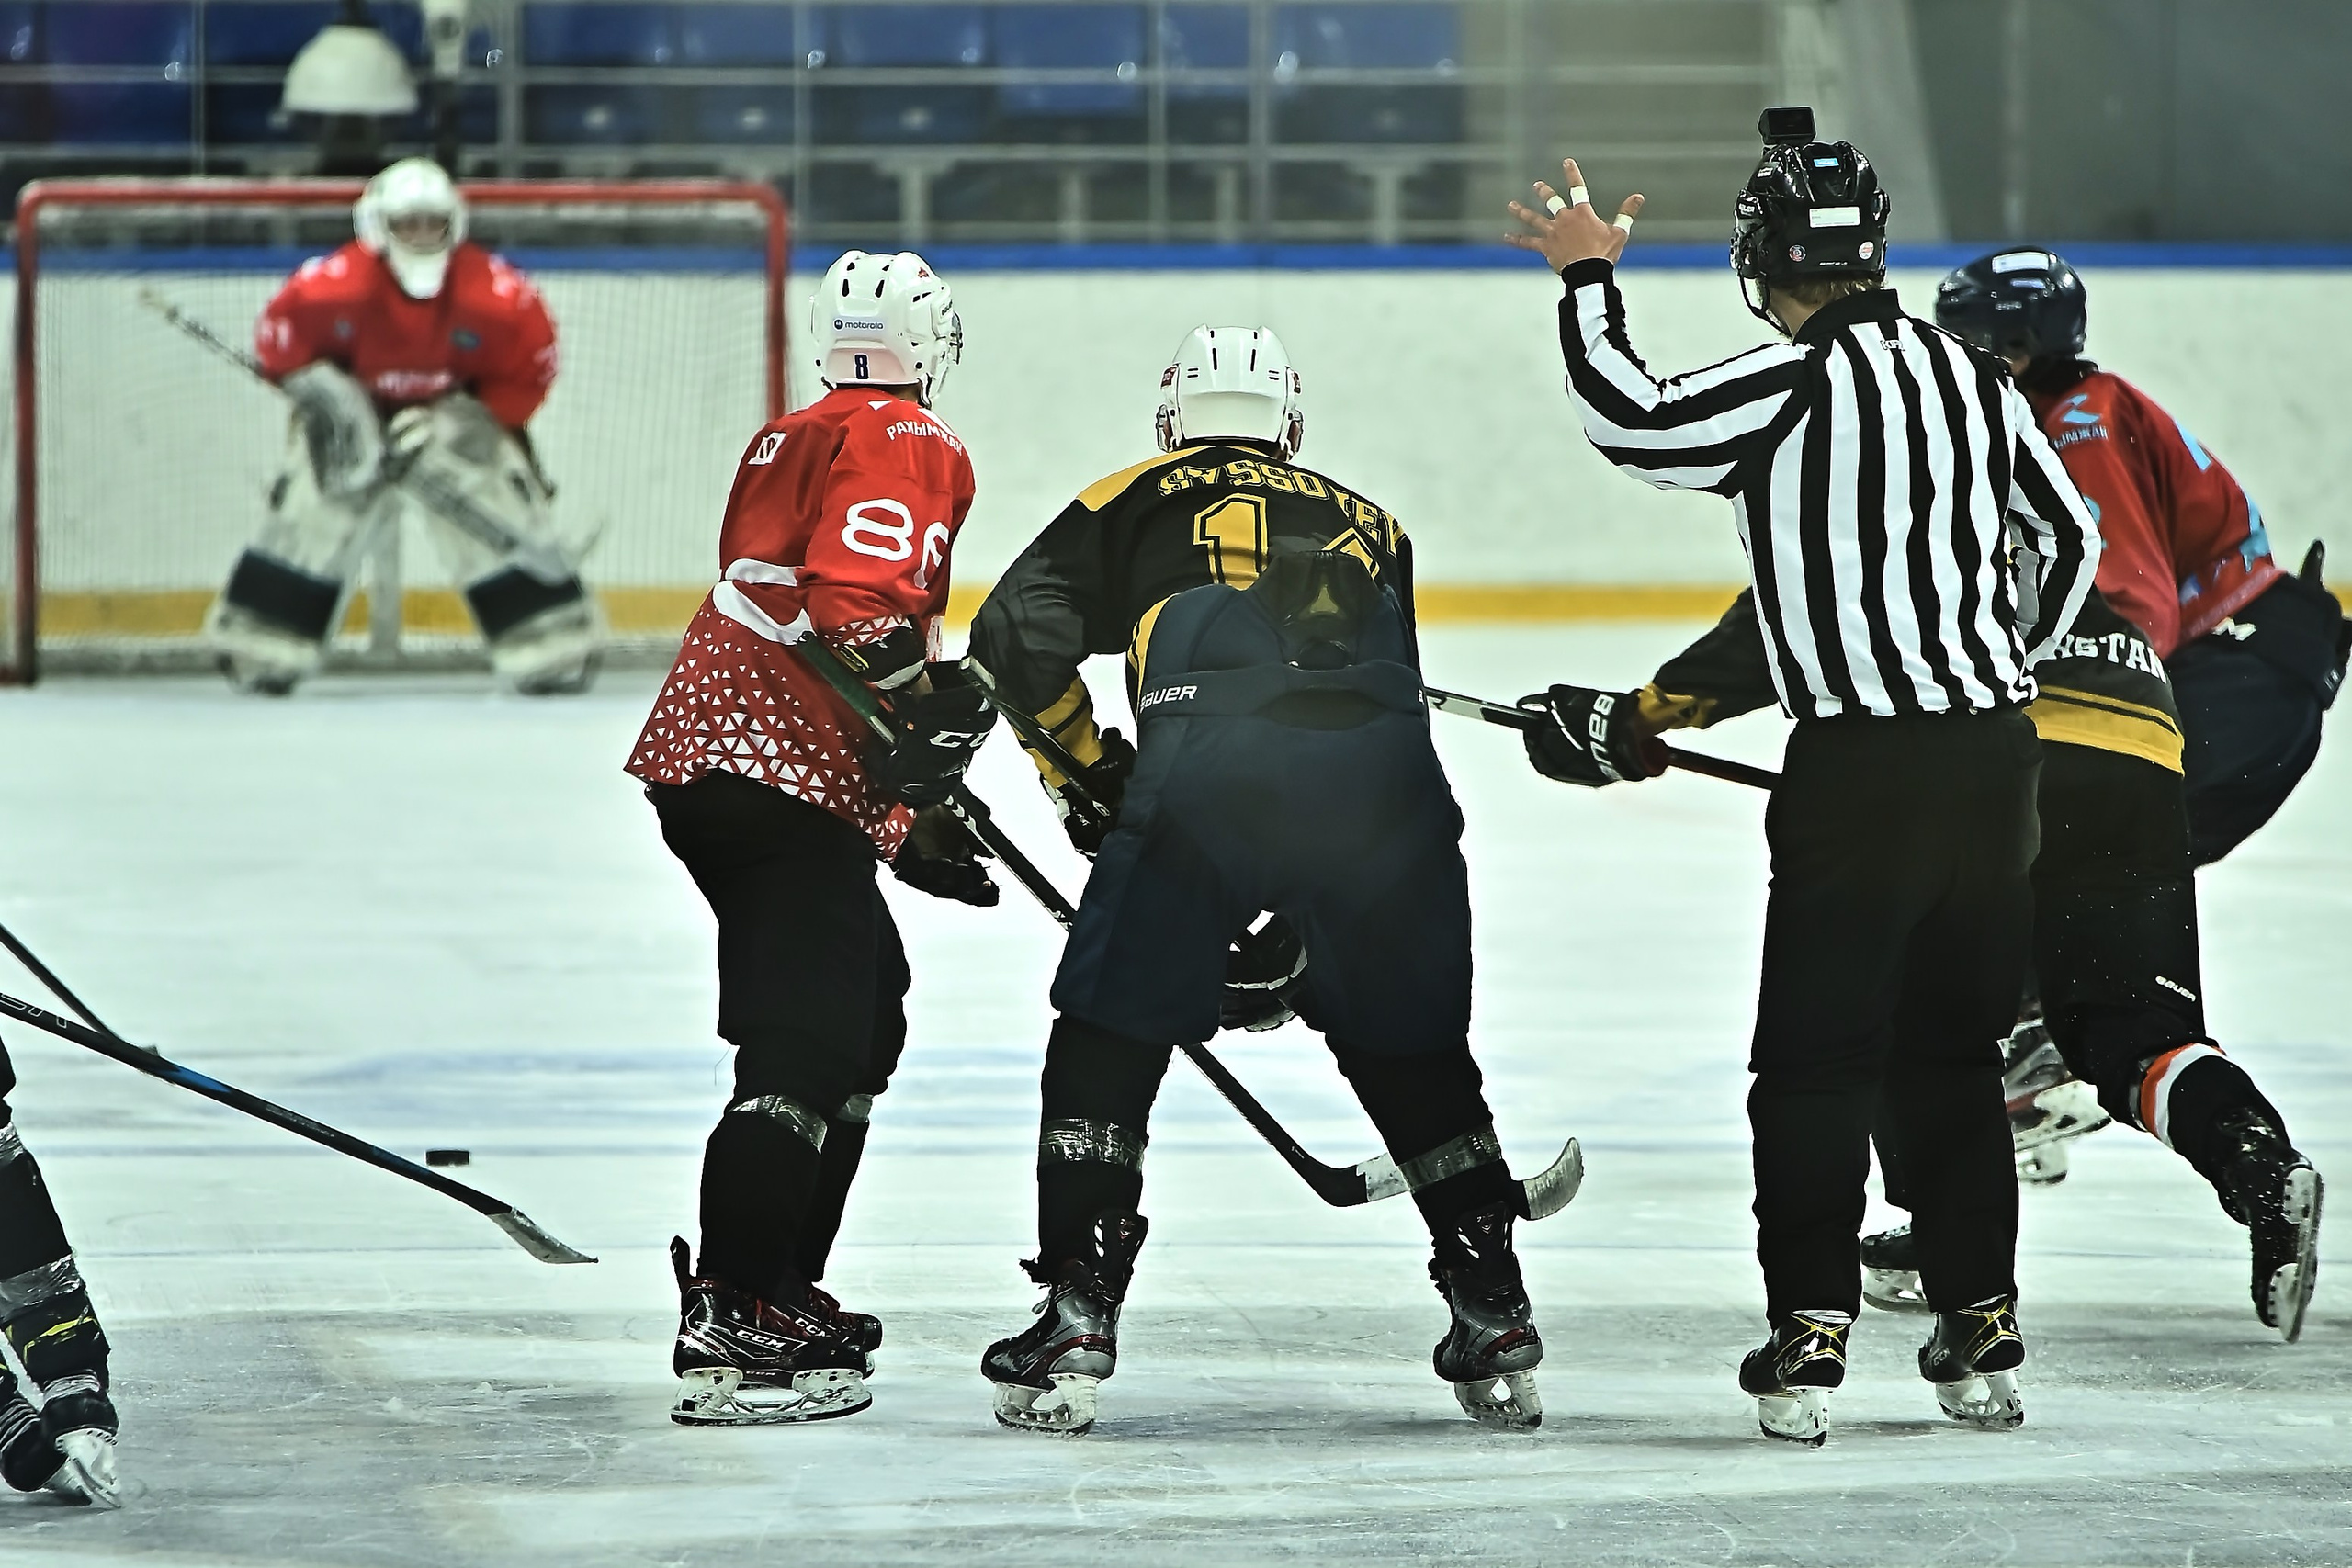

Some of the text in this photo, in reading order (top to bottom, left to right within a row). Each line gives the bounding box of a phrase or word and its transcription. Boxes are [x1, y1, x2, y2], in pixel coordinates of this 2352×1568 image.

[844, 321, 884, 330] motorola
[854, 354, 870, 380] 8
[736, 1329, 786, 1348] CCM
